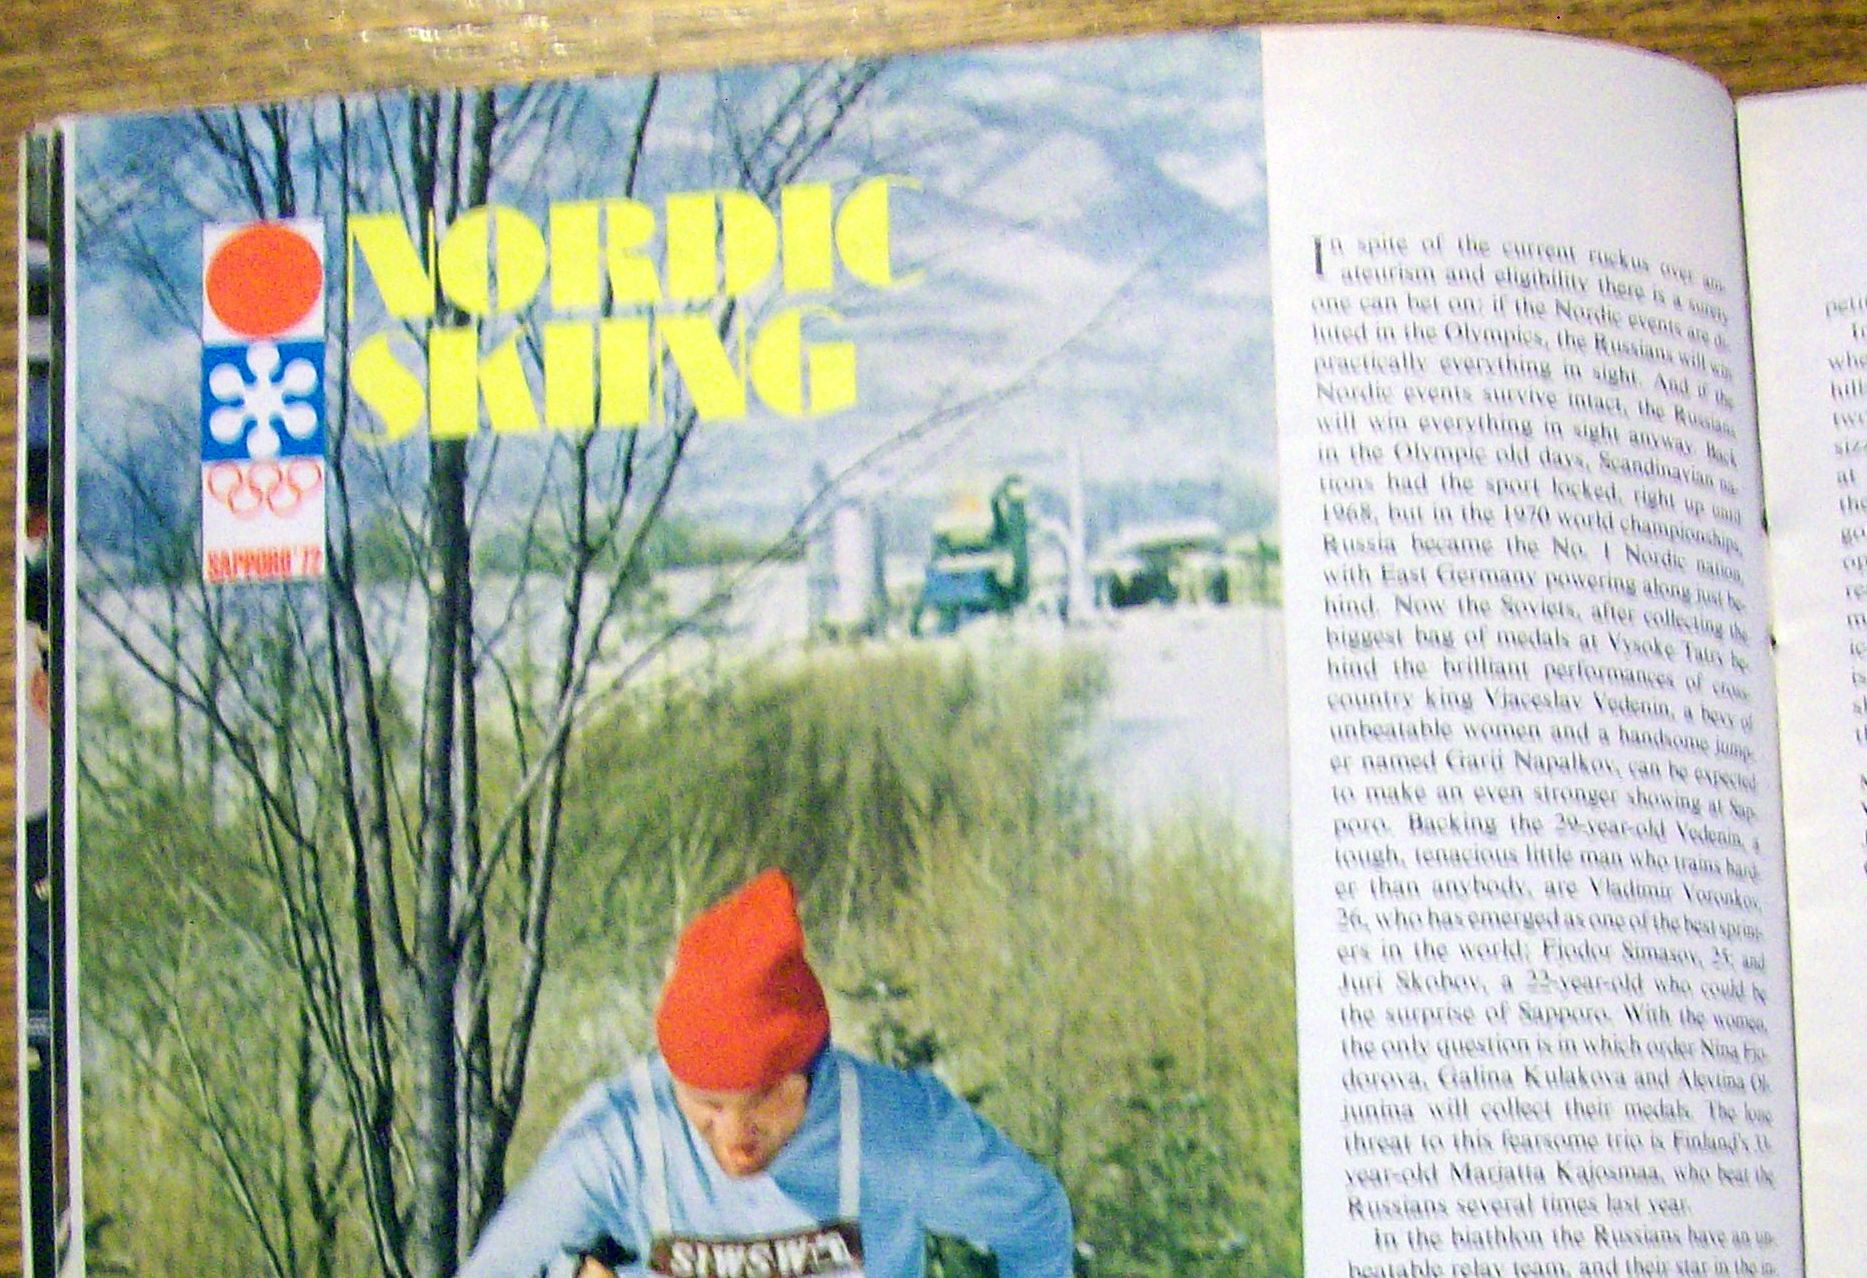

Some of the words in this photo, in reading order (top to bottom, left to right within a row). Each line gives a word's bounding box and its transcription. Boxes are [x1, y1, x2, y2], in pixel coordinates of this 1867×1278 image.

[345, 174, 924, 318] NORDIC
[1357, 233, 1409, 259] spite
[1420, 232, 1445, 256] of
[1457, 233, 1491, 257] the
[1501, 236, 1576, 264] current
[1340, 262, 1436, 285] ateurism
[1444, 261, 1486, 286] and
[1597, 273, 1646, 304] there
[1359, 295, 1398, 314] can
[1406, 290, 1440, 314] bet
[1514, 293, 1548, 319] the
[1554, 296, 1623, 329] Nordic
[1403, 320, 1438, 344] the
[345, 304, 857, 445] SKIING
[1317, 380, 1394, 404] Nordic
[1403, 381, 1474, 404] events
[1481, 383, 1558, 409] survive
[1316, 411, 1357, 435] will
[1367, 412, 1409, 434] win
[1349, 441, 1384, 465] the
[1495, 442, 1530, 467] old
[1386, 471, 1429, 495] had
[1484, 473, 1541, 501] sport
[1387, 501, 1424, 524] but
[1460, 501, 1495, 525] the
[1503, 502, 1552, 528] 1970
[1556, 505, 1615, 533] world
[1323, 532, 1398, 556] Russia
[1411, 532, 1494, 556] became
[1323, 563, 1373, 587] with
[1380, 563, 1428, 586] East
[1435, 563, 1538, 591] Germany
[1544, 567, 1638, 599] powering
[1393, 593, 1448, 617] Now
[1590, 599, 1636, 626] after
[1326, 625, 1405, 652] biggest
[1414, 625, 1456, 651] bag
[1495, 625, 1572, 652] medals
[1327, 655, 1378, 679] hind
[1327, 688, 1414, 713] country
[1424, 686, 1475, 713] king
[1462, 722, 1543, 742] women
[1549, 719, 1591, 745] and
[1360, 749, 1438, 773] named
[1365, 780, 1427, 804] make
[1472, 785, 1525, 804] even
[1532, 782, 1619, 811] stronger
[1407, 811, 1498, 838] Backing
[1509, 812, 1545, 836] the
[1525, 843, 1575, 868] little
[1579, 849, 1625, 870] man
[1369, 875, 1421, 899] than
[1544, 879, 1579, 899] are
[1374, 907, 1424, 931] who
[1466, 906, 1561, 933] emerged
[1413, 937, 1449, 961] the
[1340, 1002, 1376, 1026] the
[1384, 1003, 1477, 1028] surprise
[1623, 1002, 1673, 1028] With
[1380, 1033, 1431, 1061] only
[1435, 1034, 1531, 1060] question
[1582, 1033, 1644, 1058] which
[1436, 1065, 1515, 1089] Galina
[1633, 1066, 1671, 1090] and
[1426, 1097, 1470, 1121] will
[1480, 1097, 1553, 1121] collect
[1564, 1097, 1614, 1120] their
[1344, 1130, 1413, 1154] threat
[1452, 1129, 1494, 1153] this
[1501, 1128, 1600, 1152] fearsome
[1605, 1130, 1645, 1152] trio
[1345, 1162, 1439, 1190] year-old
[1348, 1194, 1449, 1219] Russians
[1455, 1193, 1536, 1218] several
[1541, 1194, 1601, 1216] times
[1606, 1192, 1642, 1216] last
[1374, 1227, 1399, 1251] In
[1406, 1226, 1444, 1250] the
[1451, 1225, 1545, 1250] biathlon
[1593, 1224, 1683, 1247] Russians
